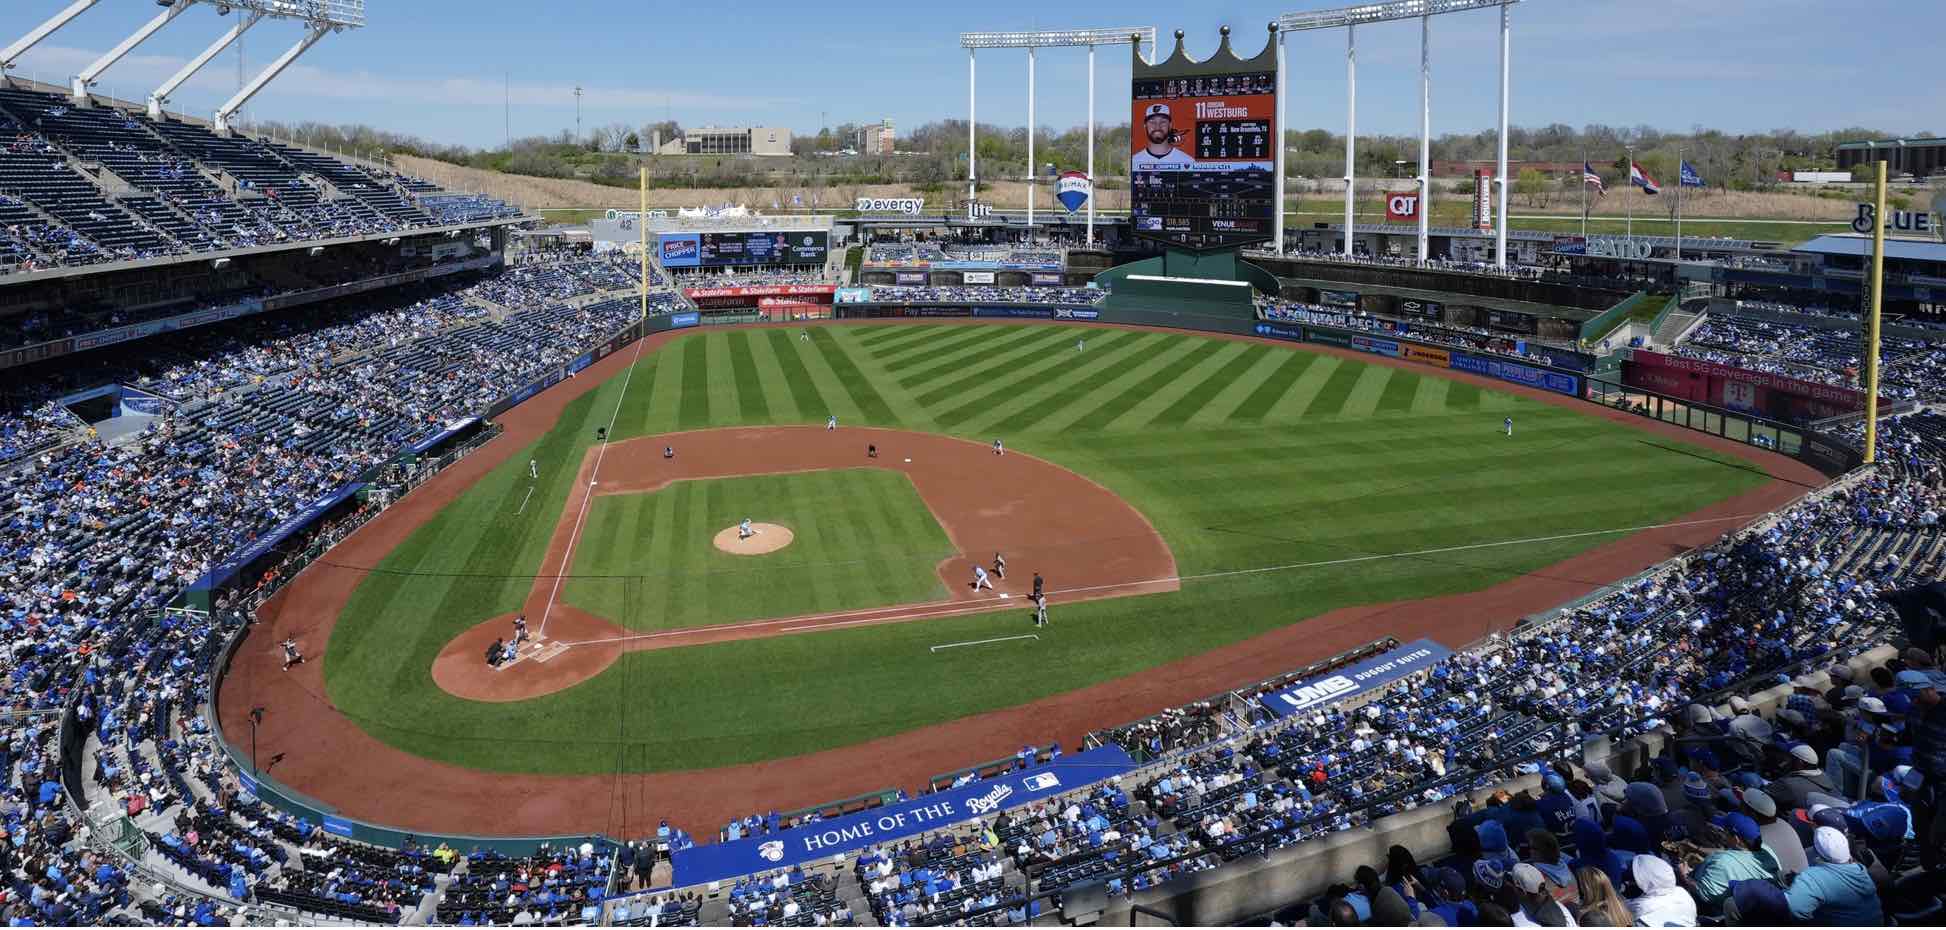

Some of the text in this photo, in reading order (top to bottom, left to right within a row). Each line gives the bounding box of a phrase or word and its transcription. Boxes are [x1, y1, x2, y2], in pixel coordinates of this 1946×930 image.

[1195, 102, 1206, 119] 11
[1207, 107, 1248, 118] WESTBURG
[874, 200, 923, 213] evergy
[1390, 196, 1417, 216] QT
[664, 247, 695, 259] CHOPPER
[1587, 239, 1652, 258] PATIO
[1287, 309, 1347, 325] FOUNTAIN
[1664, 356, 1689, 369] Best
[1694, 360, 1709, 374] 5G
[1712, 367, 1768, 385] coverage
[1786, 379, 1809, 394] the
[1812, 386, 1852, 403] game
[1355, 648, 1432, 680] DUGOUT SUITES
[1280, 675, 1354, 705] UMB
[803, 783, 1013, 851] HOME OF THE Royals
